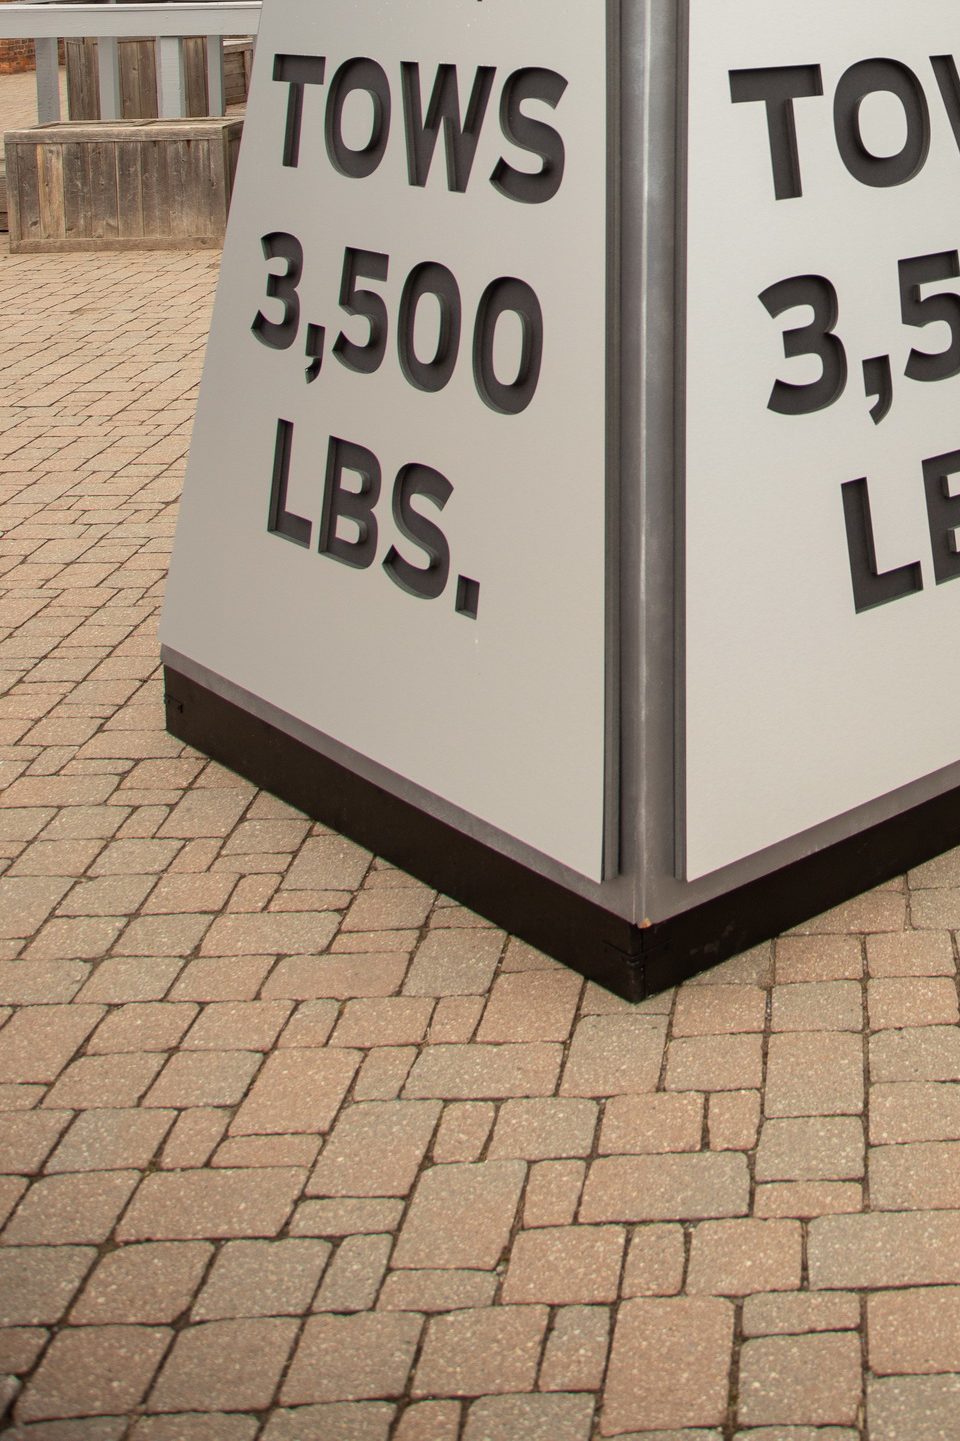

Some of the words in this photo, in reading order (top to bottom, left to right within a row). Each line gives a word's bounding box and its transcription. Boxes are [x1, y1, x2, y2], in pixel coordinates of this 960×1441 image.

[271, 53, 569, 205] TOWS
[250, 231, 544, 416] 3,500
[266, 417, 481, 621] LBS.
